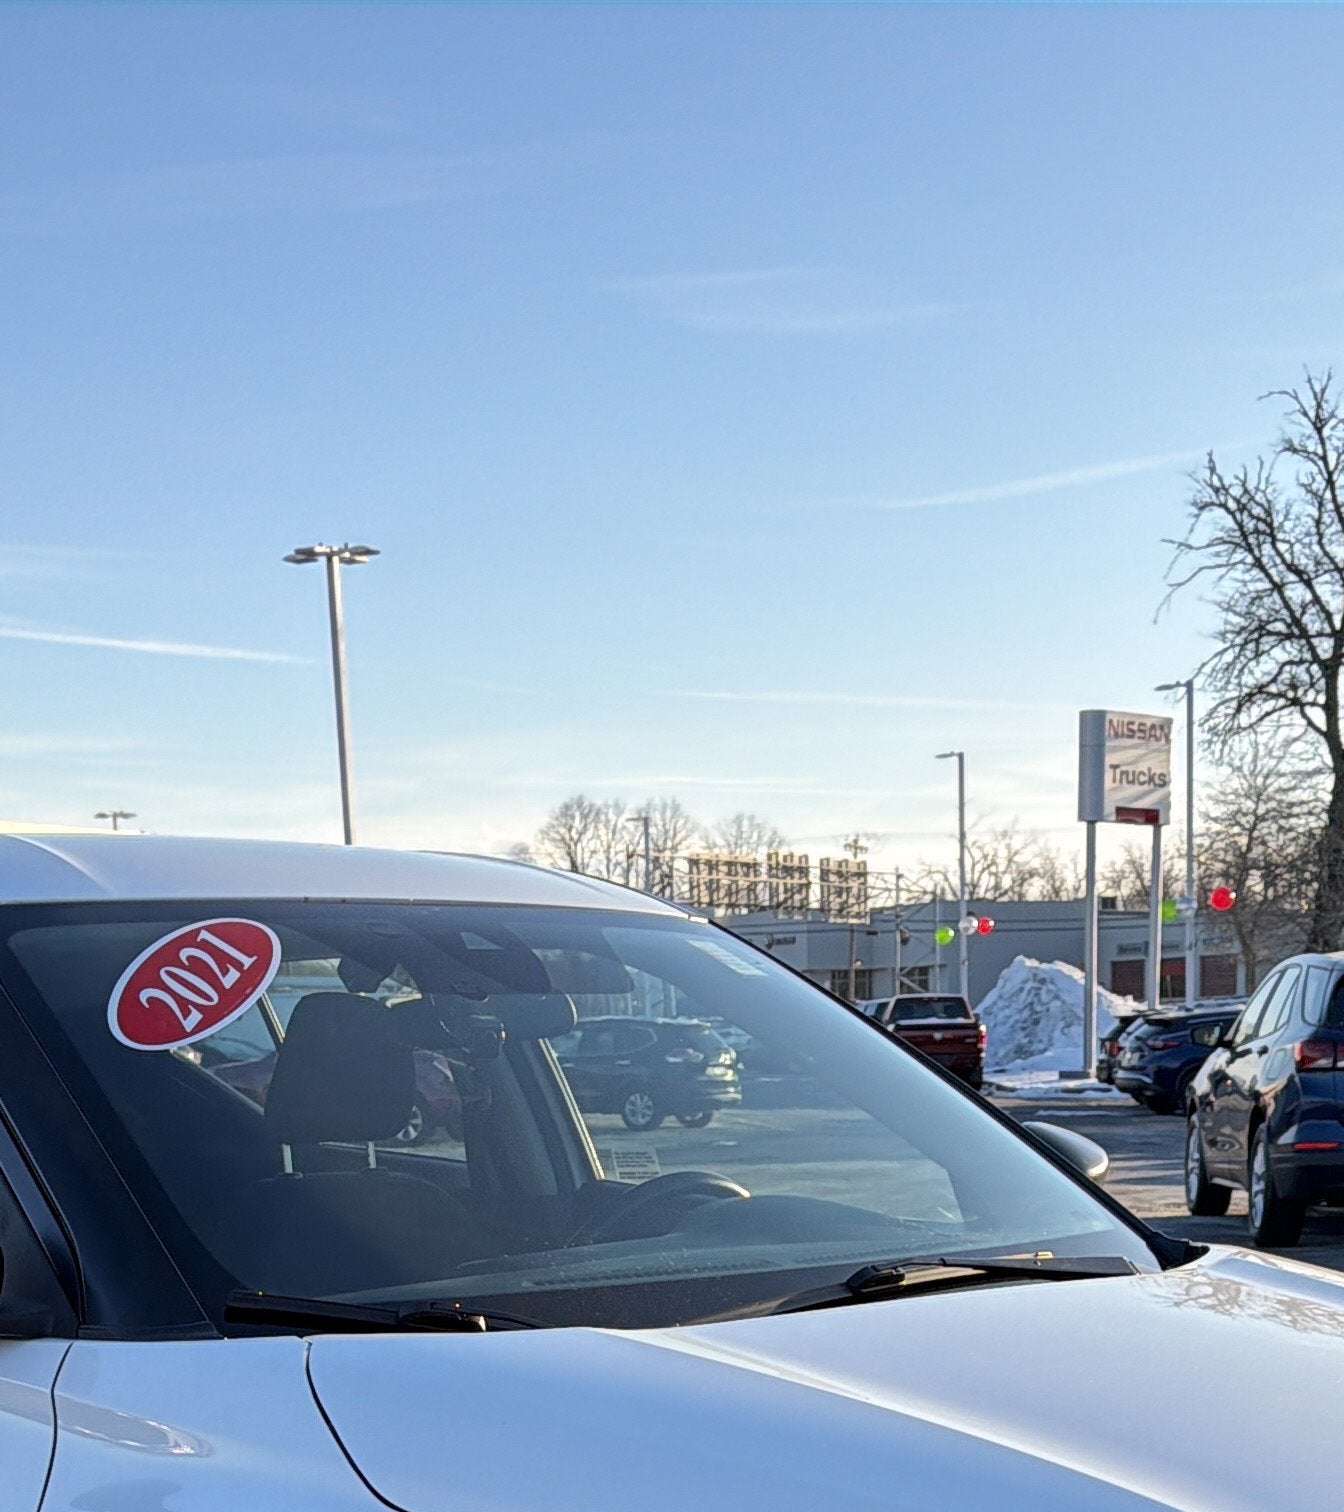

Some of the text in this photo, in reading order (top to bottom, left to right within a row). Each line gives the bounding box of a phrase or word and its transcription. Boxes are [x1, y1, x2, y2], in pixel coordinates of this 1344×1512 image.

[1108, 718, 1171, 744] NISSAN
[1109, 763, 1167, 788] Trucks
[139, 929, 258, 1033] 2021
